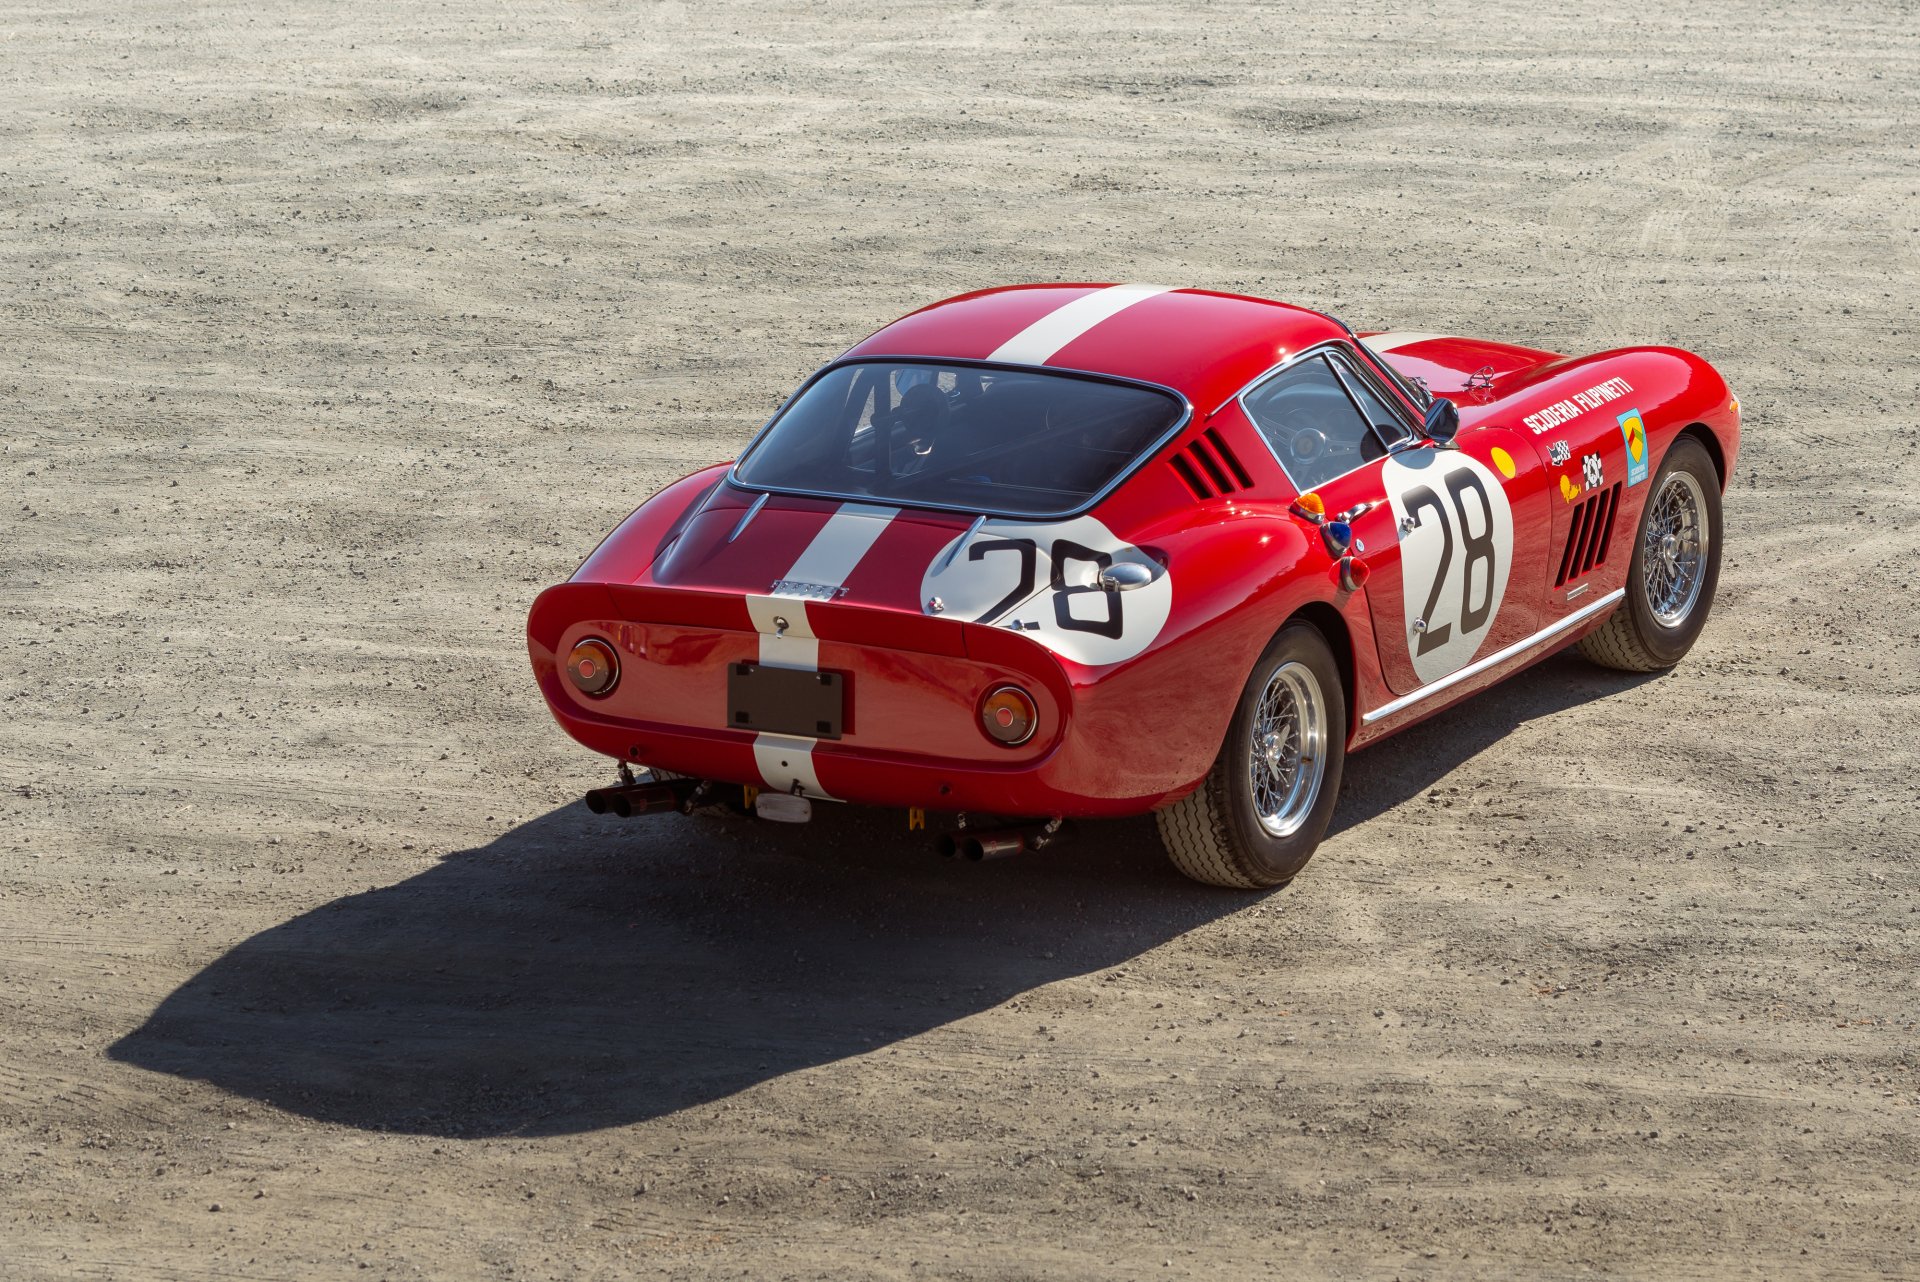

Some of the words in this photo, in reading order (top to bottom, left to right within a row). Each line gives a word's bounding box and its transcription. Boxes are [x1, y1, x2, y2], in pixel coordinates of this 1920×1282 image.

[1522, 399, 1584, 435] SCUDERIA
[1572, 376, 1634, 412] FILIPINETTI
[968, 538, 1124, 640] 28
[1401, 466, 1495, 658] 28
